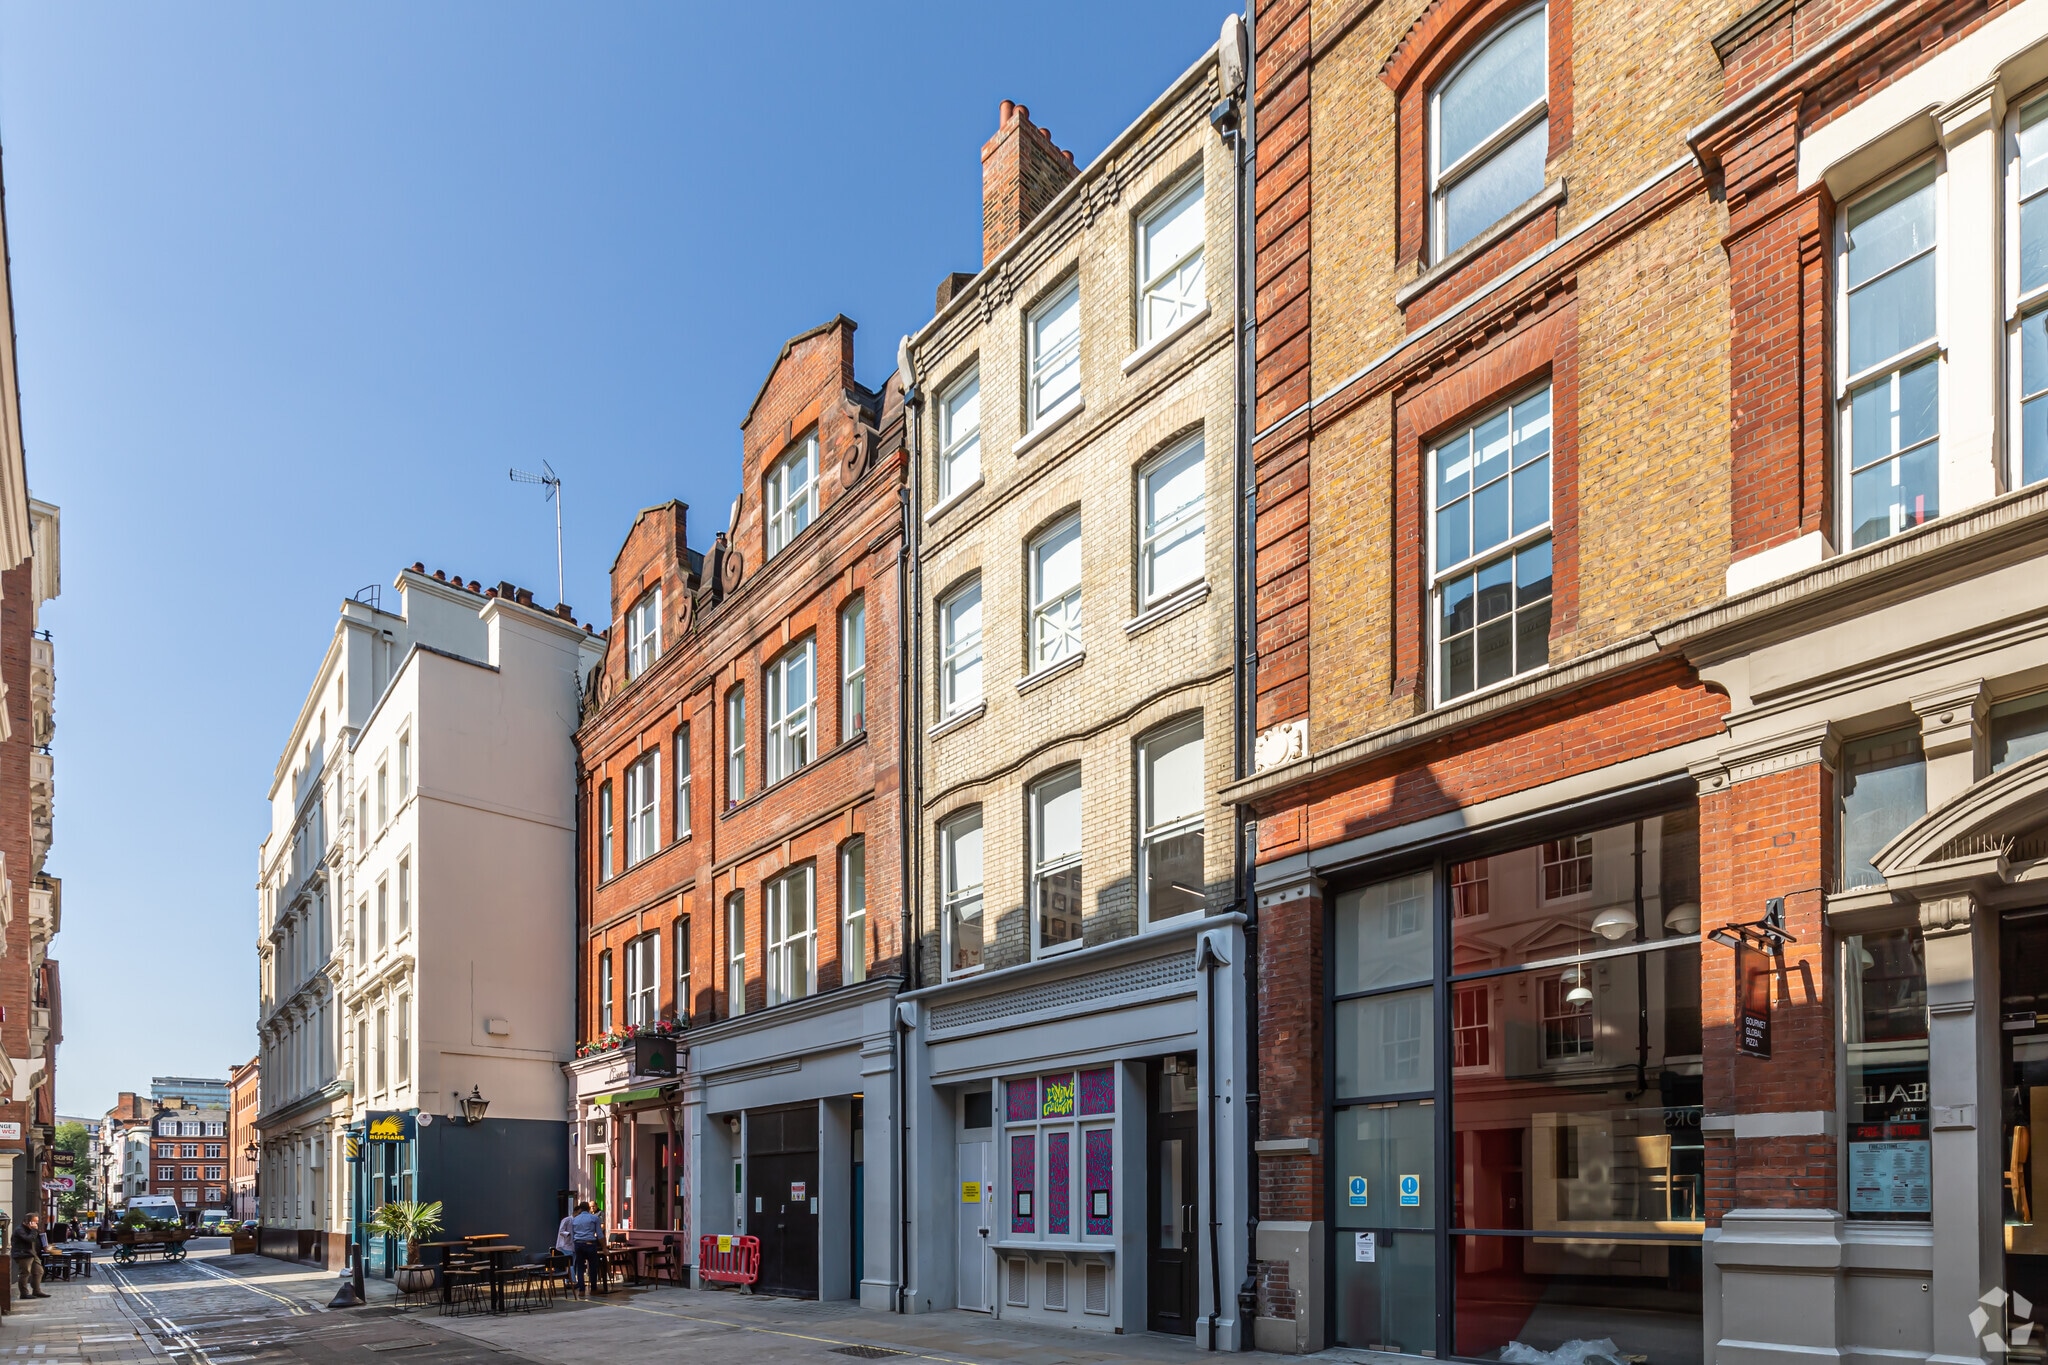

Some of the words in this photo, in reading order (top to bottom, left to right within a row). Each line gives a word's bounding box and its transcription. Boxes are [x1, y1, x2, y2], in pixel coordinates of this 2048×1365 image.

[1745, 1016, 1766, 1029] GOURMET
[1745, 1027, 1763, 1038] GLOBAL
[1745, 1037, 1758, 1047] PIZZA
